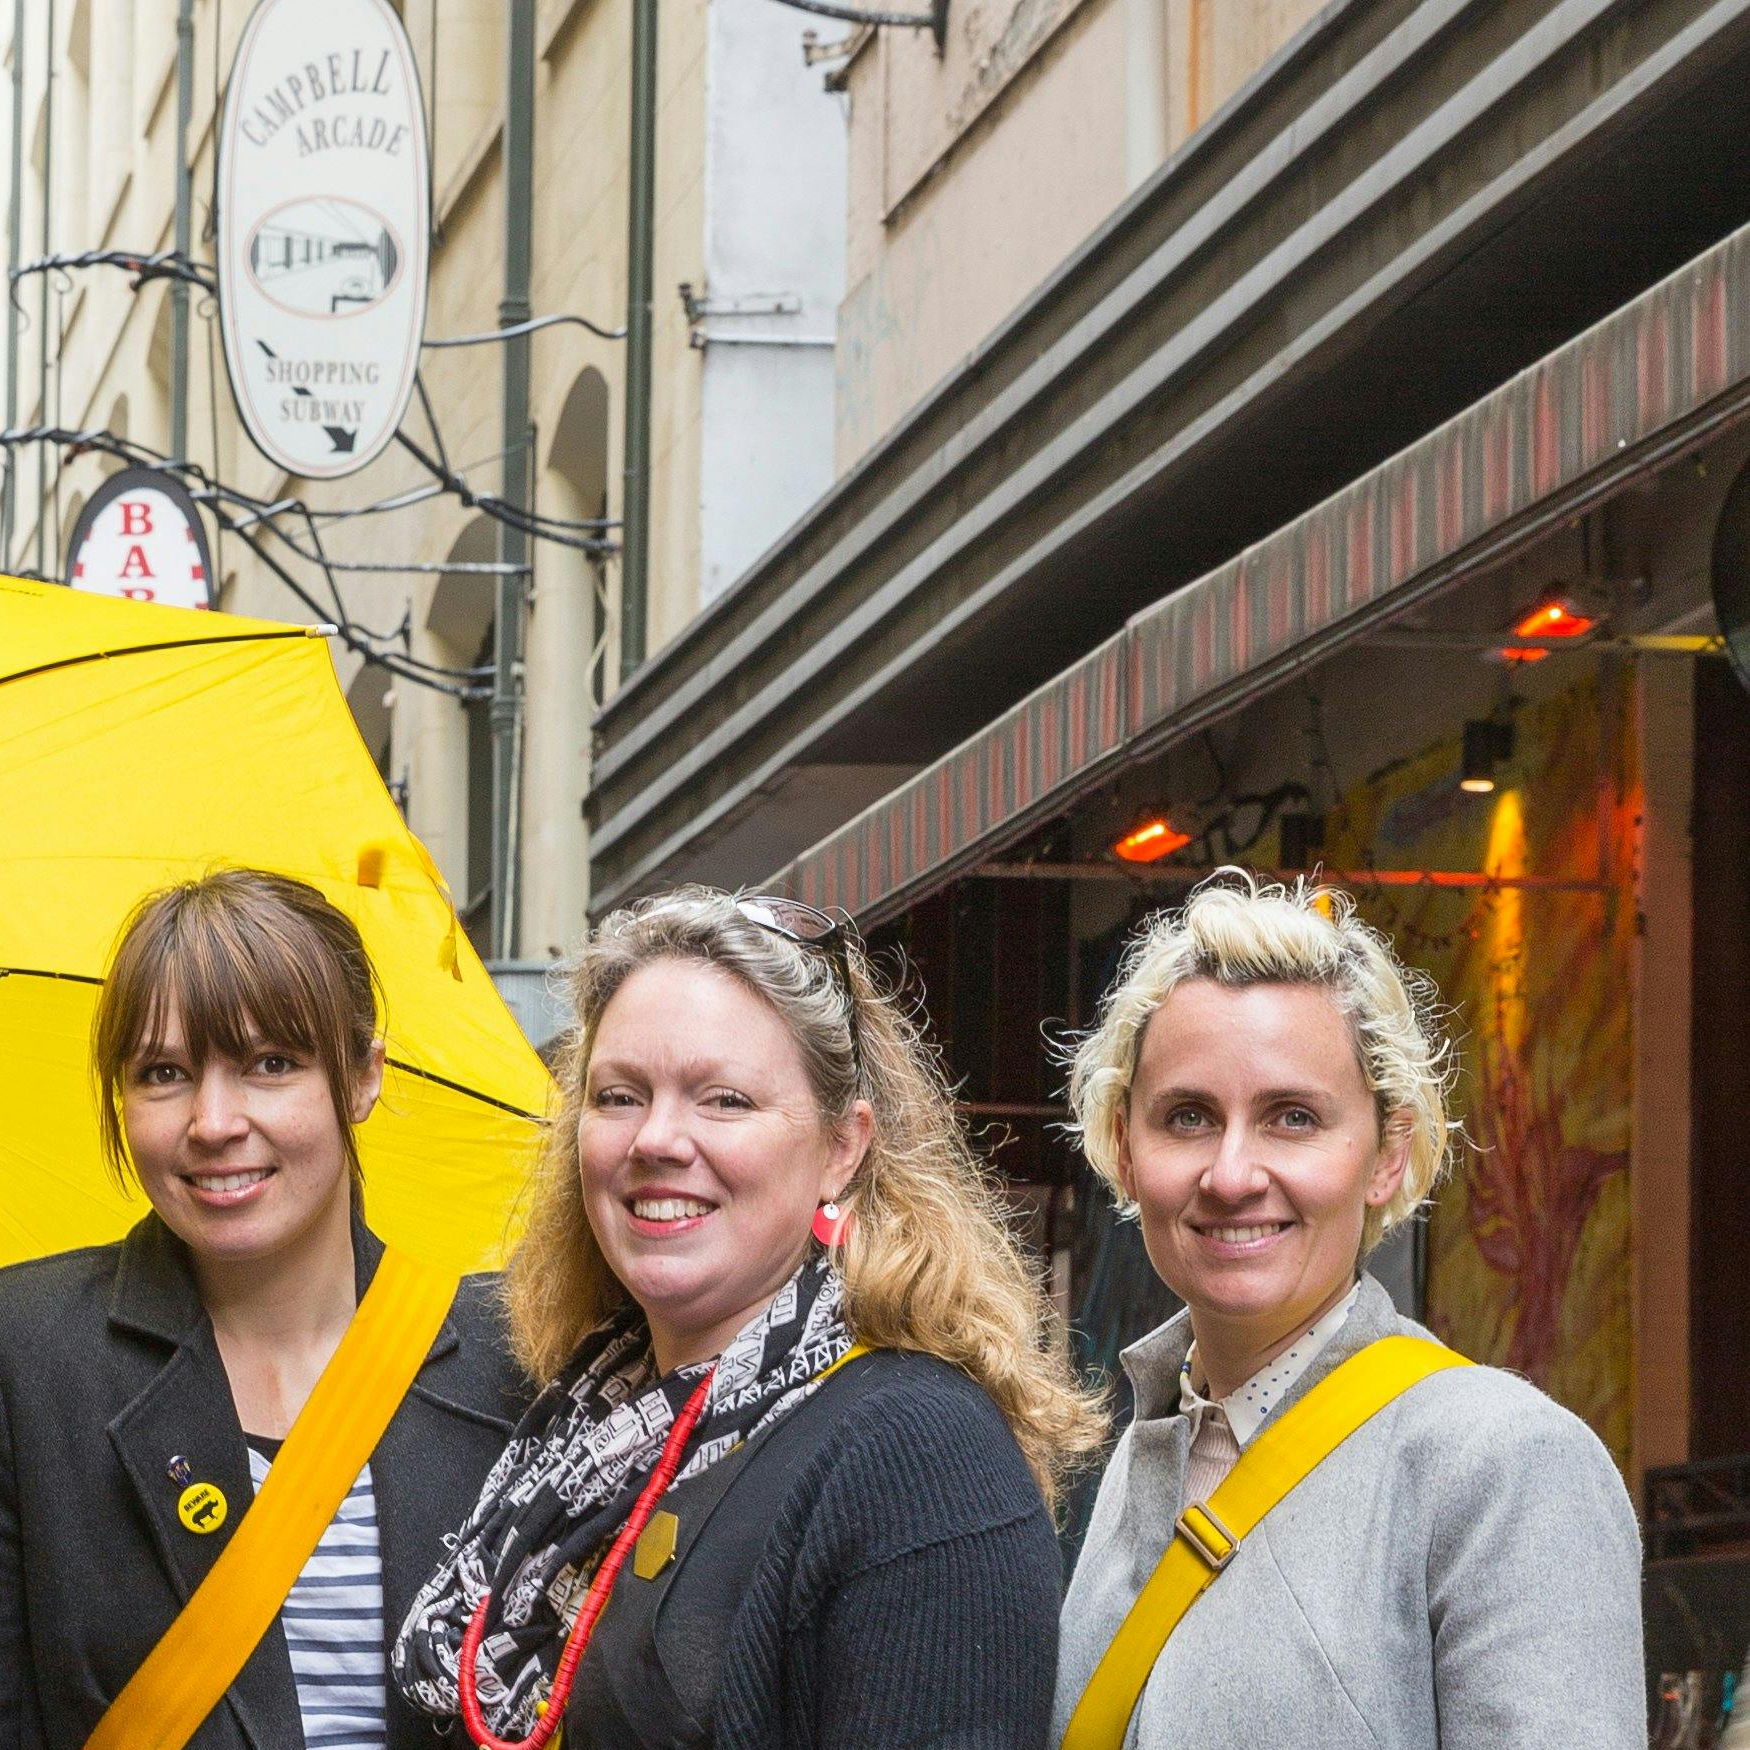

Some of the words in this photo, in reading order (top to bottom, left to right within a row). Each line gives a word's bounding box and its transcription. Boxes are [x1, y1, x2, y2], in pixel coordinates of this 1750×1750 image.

[240, 49, 390, 147] CAMPBELL
[296, 115, 410, 157] ARCADE
[266, 359, 379, 384] SHOPPING
[281, 399, 366, 422] SUBWAY
